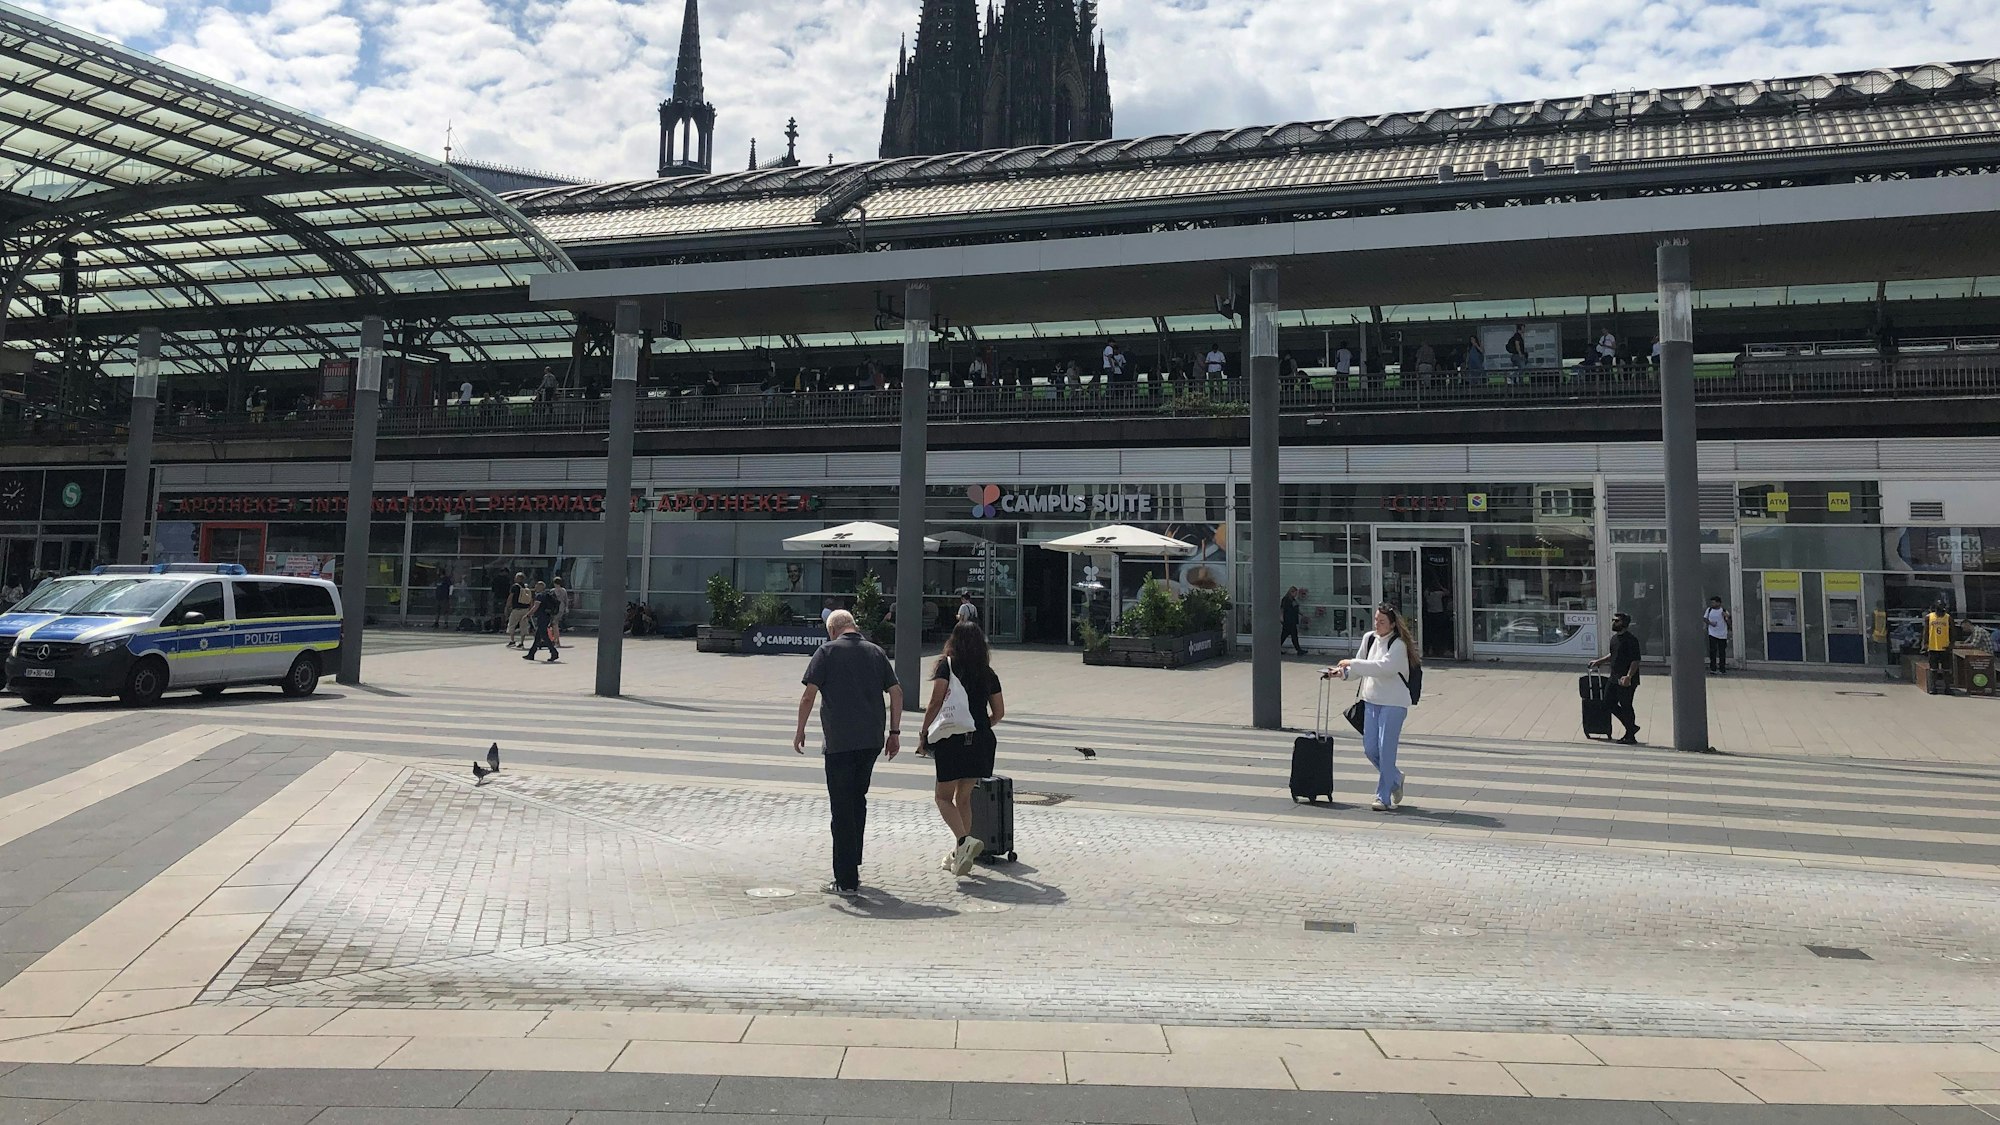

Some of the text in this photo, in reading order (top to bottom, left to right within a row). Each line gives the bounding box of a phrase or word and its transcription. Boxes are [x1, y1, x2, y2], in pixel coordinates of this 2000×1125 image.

[178, 493, 788, 513] APOTHEKE INTNATIONAL PHARMAC APOTHEKE
[1001, 493, 1151, 513] CAMPUS SUITE
[1936, 627, 1942, 635] 6
[244, 633, 282, 644] POLIZEI
[766, 635, 828, 646] CAMPUS SUITE
